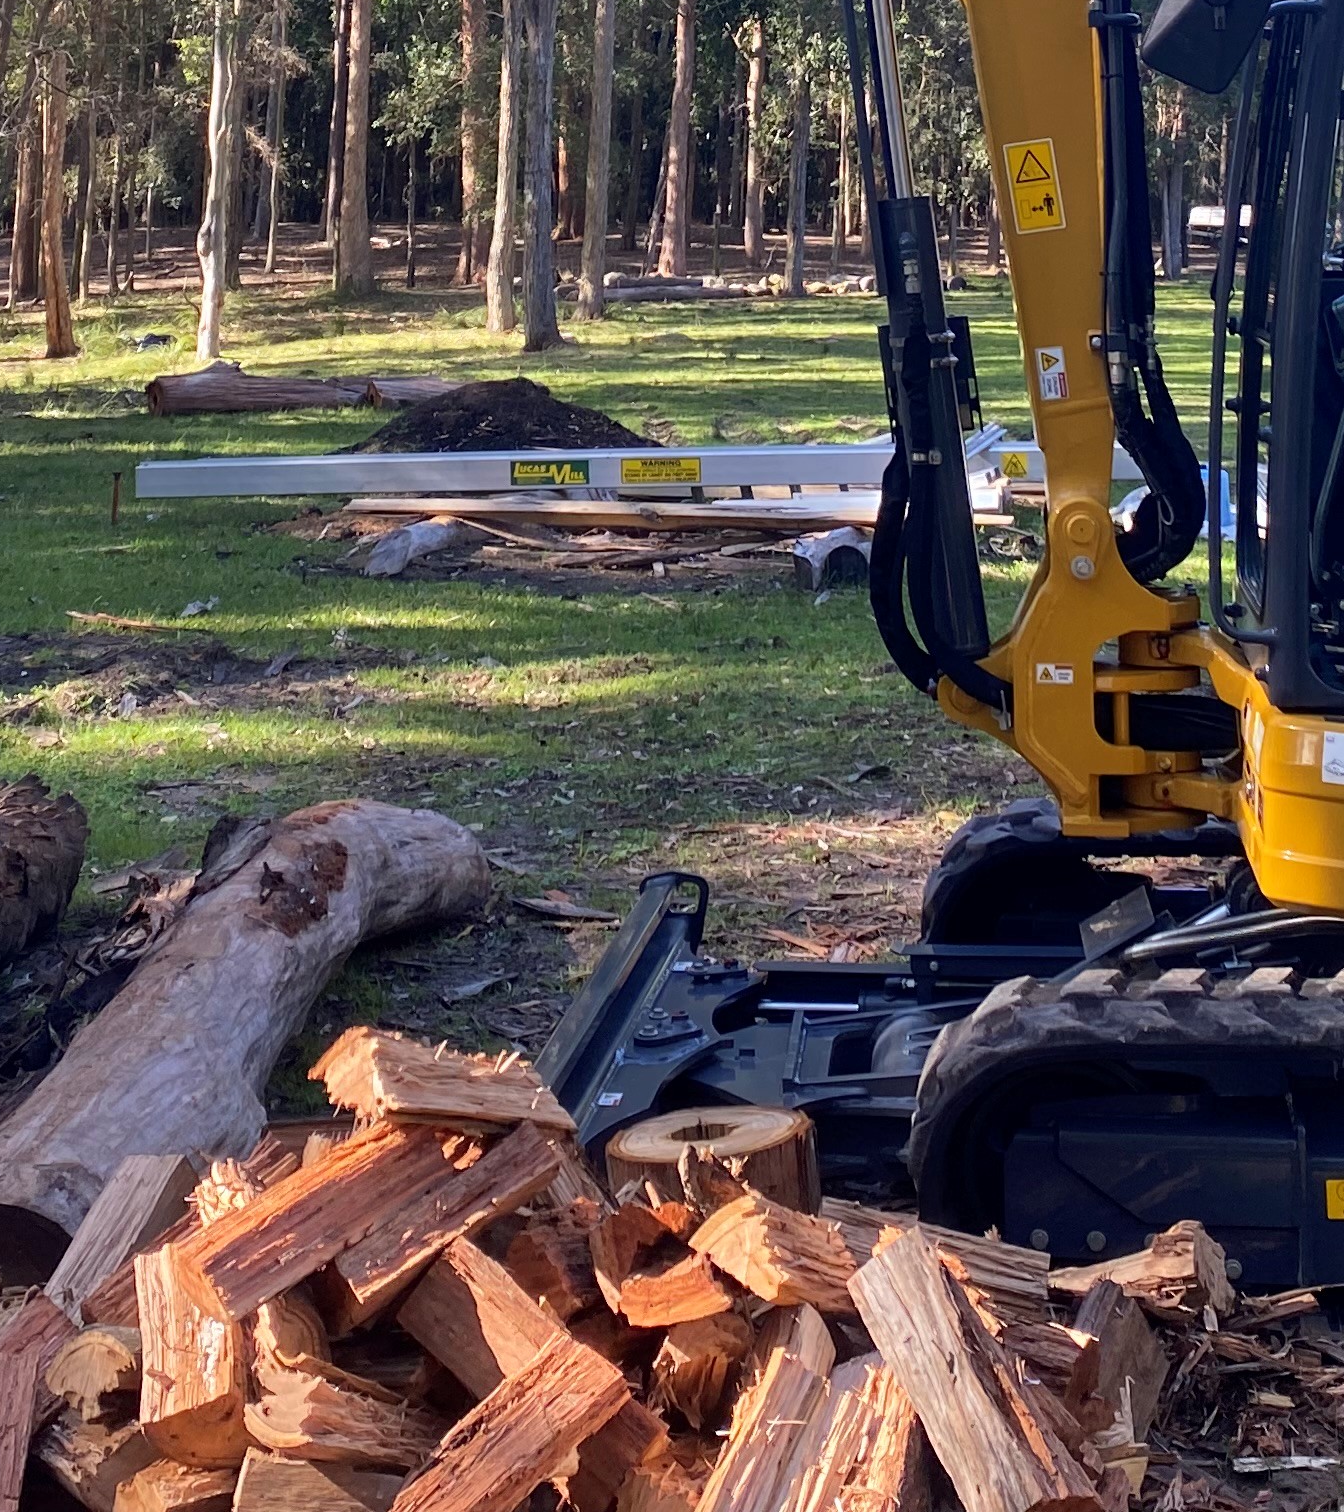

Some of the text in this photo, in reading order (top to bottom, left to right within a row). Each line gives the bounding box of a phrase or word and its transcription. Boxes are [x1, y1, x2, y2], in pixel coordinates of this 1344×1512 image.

[640, 459, 682, 467] WARNING
[513, 462, 587, 484] LUCAS MILL
